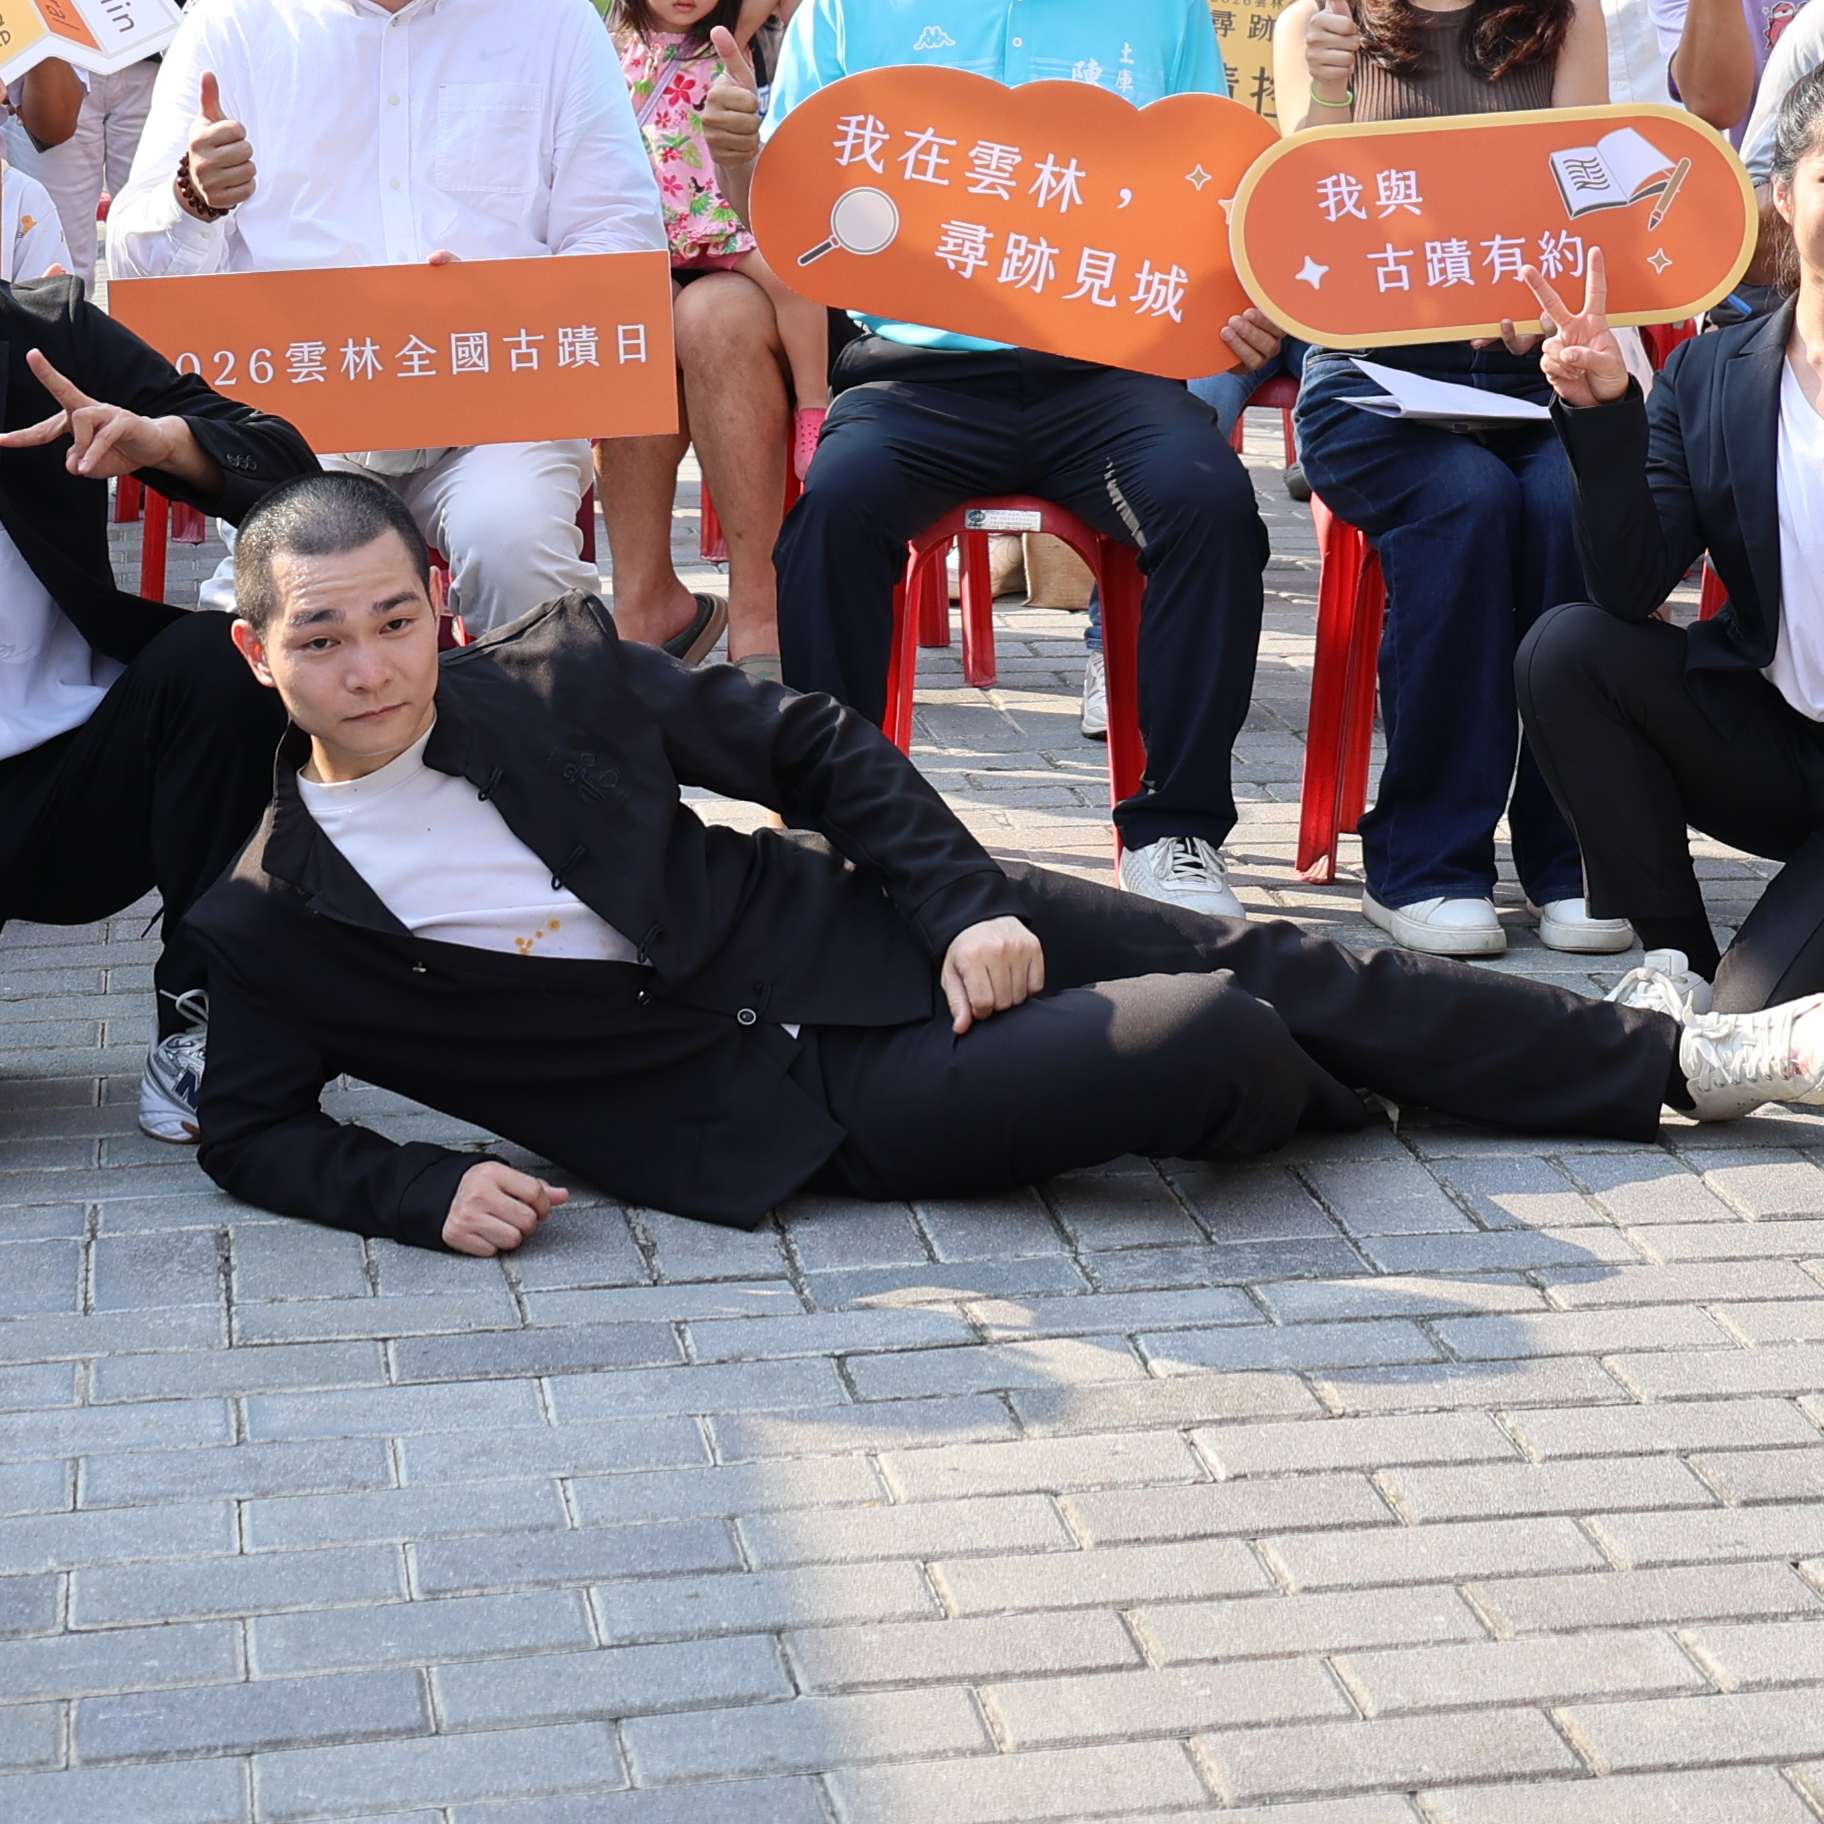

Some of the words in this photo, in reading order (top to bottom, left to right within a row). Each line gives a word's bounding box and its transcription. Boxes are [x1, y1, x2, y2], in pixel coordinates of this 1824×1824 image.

[1113, 41, 1134, 93] 土庫
[832, 113, 1134, 213] 我在雲林，
[1316, 167, 1423, 224] 我與
[934, 219, 1190, 324] 尋跡見城
[1367, 228, 1586, 295] 古蹟有約
[176, 321, 649, 388] 026雲林全國古蹟日
